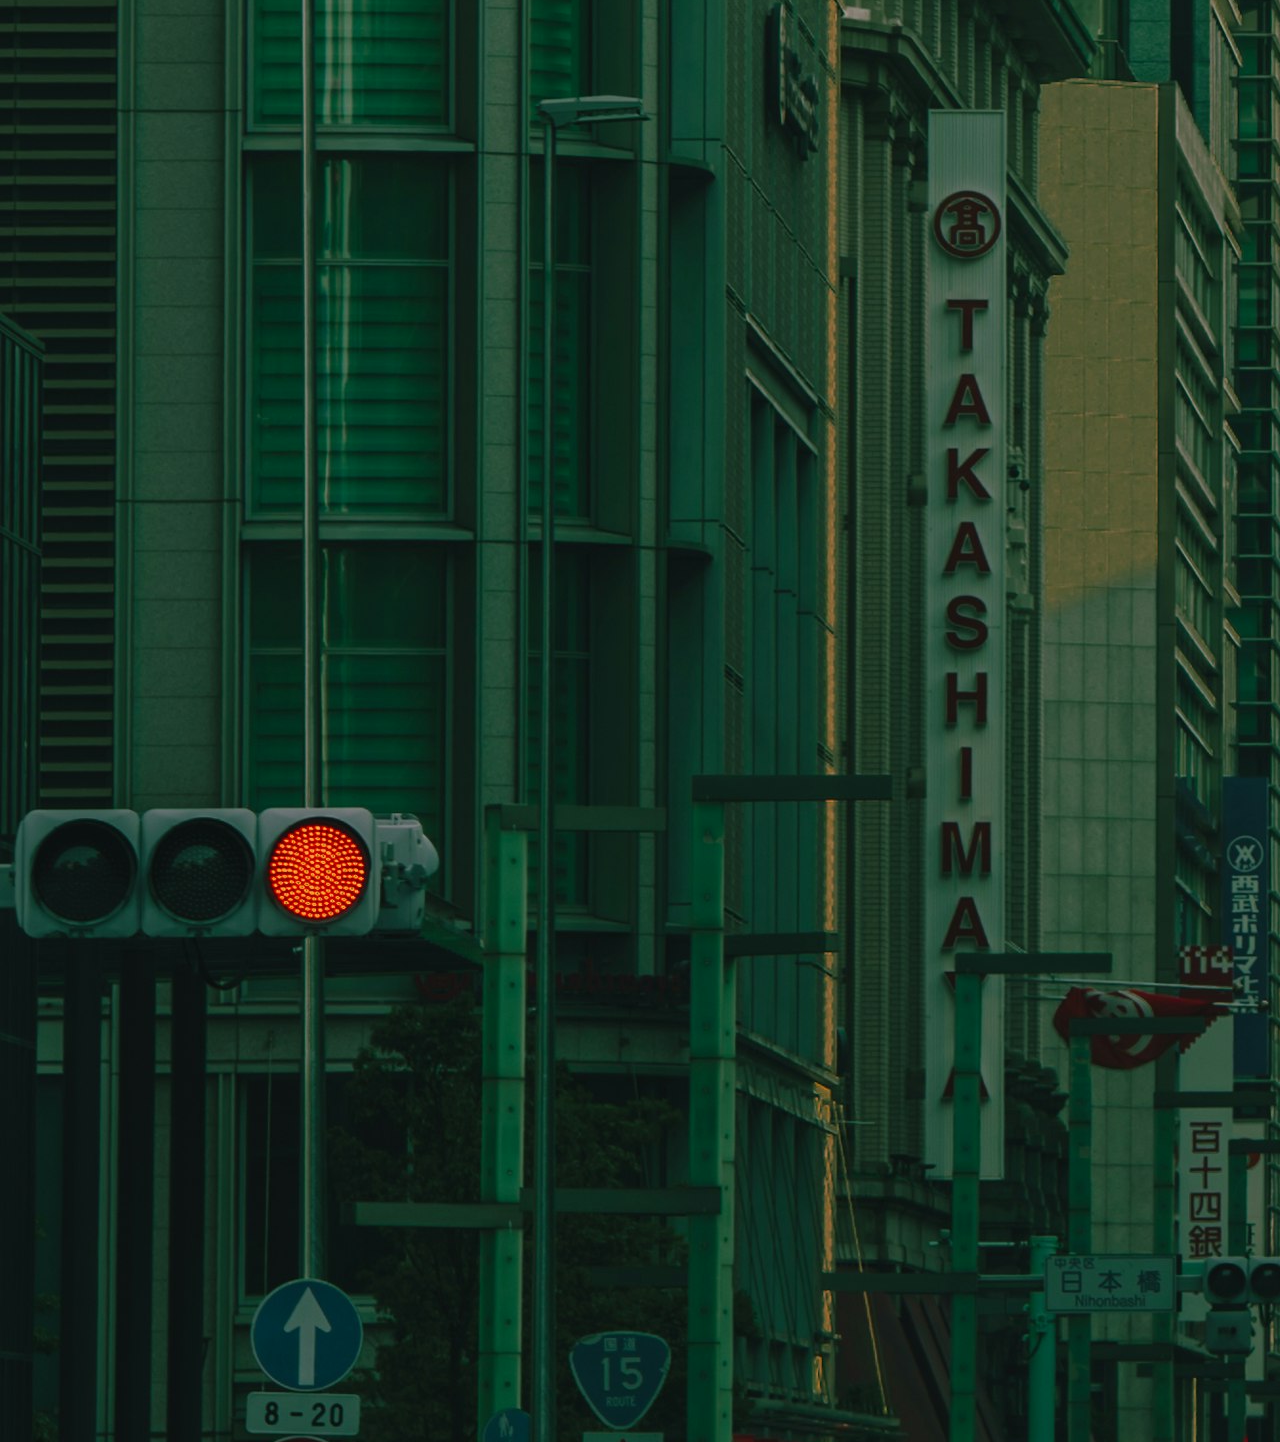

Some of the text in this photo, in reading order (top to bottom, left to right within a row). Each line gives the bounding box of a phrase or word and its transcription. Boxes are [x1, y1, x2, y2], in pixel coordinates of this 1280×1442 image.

[1231, 876, 1259, 1013] 西武ポリマ化成
[1179, 946, 1234, 974] 114
[1189, 1122, 1222, 1258] 百十四銀
[1054, 1257, 1096, 1270] 中央区
[1061, 1270, 1162, 1293] 日本橋
[1074, 1295, 1147, 1308] Nihonbashi
[603, 1337, 637, 1352] 国道
[601, 1356, 643, 1392] 15
[605, 1396, 637, 1408] ROUTE
